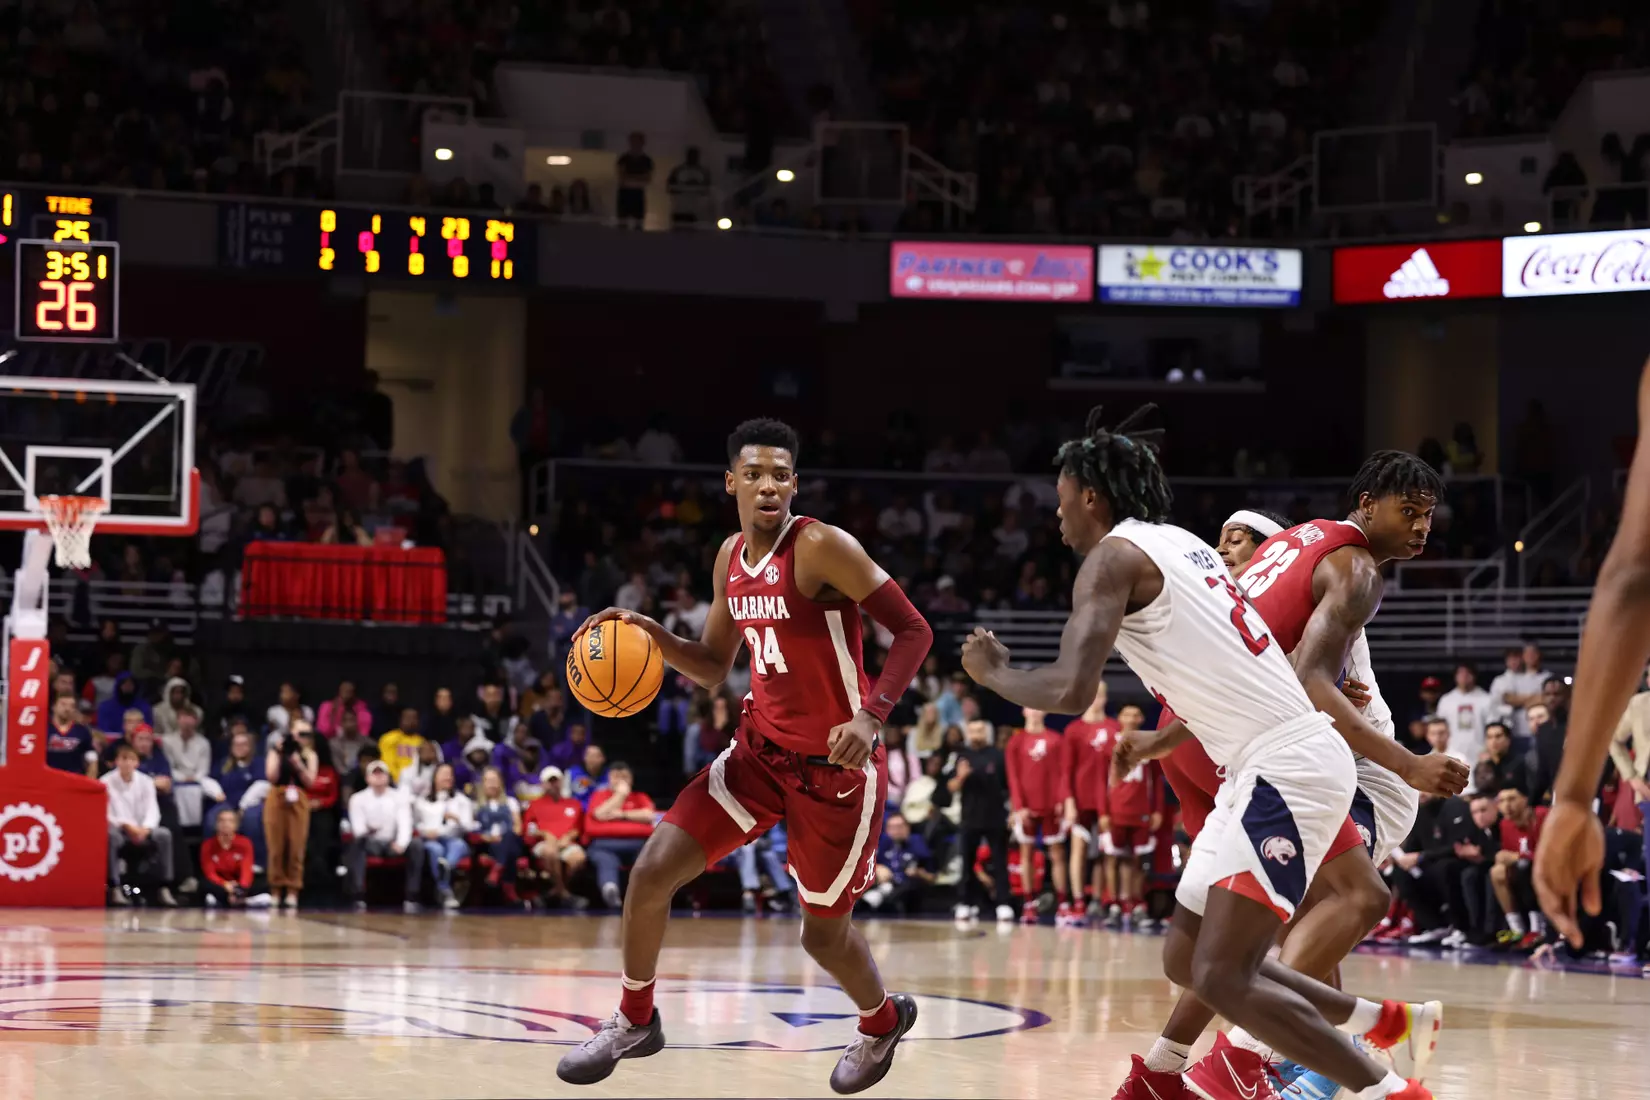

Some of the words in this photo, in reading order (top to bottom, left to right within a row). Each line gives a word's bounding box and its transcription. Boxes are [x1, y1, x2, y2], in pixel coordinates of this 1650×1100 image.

[36, 280, 96, 331] 26
[1237, 541, 1300, 599] 23
[744, 627, 789, 675] 24
[3, 825, 44, 860] pf
